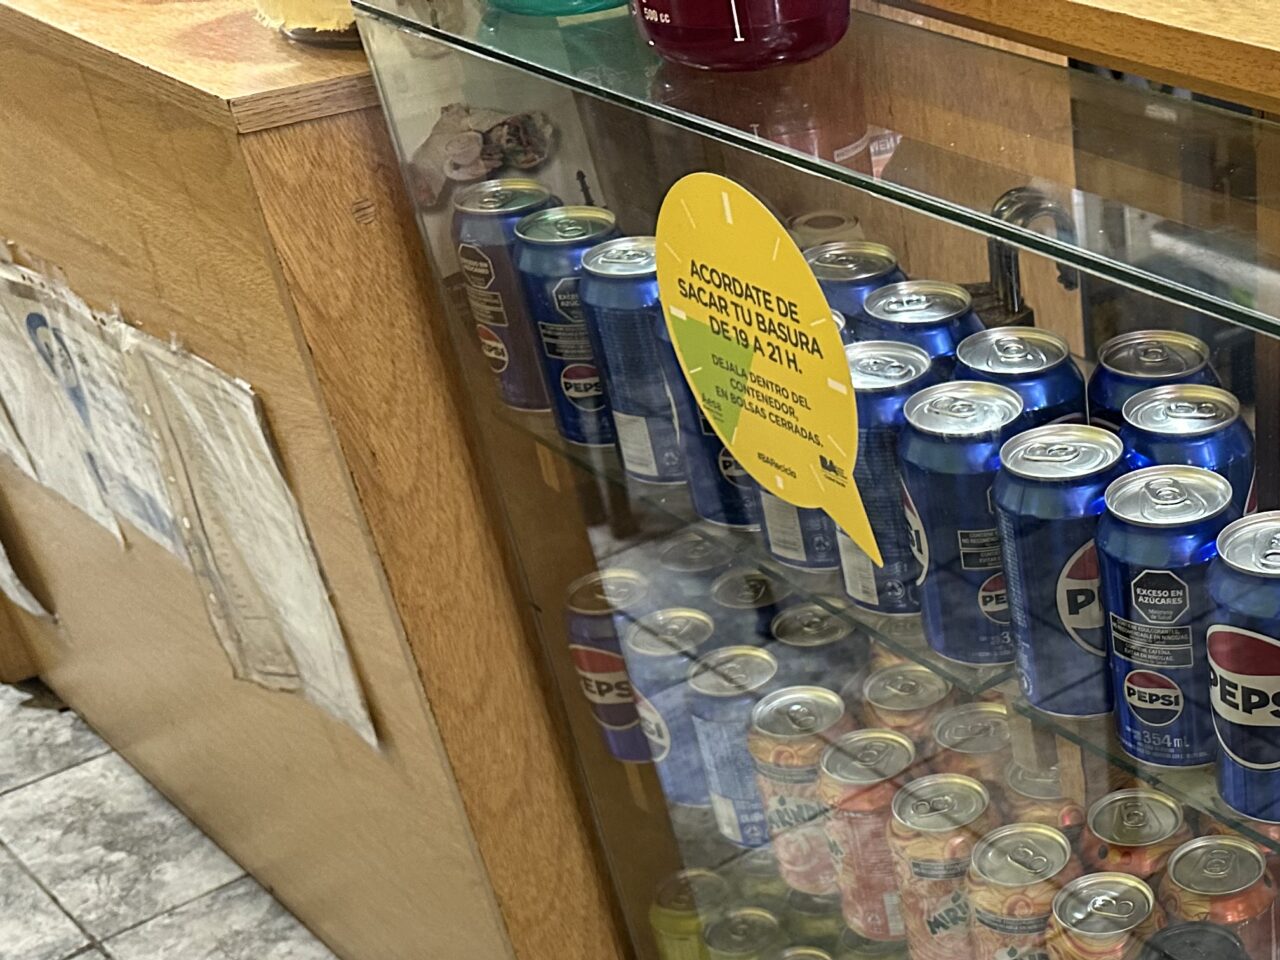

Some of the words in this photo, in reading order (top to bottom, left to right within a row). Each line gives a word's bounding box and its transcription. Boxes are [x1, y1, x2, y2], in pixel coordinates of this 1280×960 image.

[678, 277, 730, 317] SACAR
[730, 302, 753, 326] TU
[755, 312, 824, 360] BASURA
[690, 259, 774, 312] ACORDATE
[776, 296, 800, 324] DE
[709, 315, 732, 341] DE
[733, 326, 750, 349] 19
[753, 336, 766, 357] A
[766, 342, 784, 365] 21
[785, 350, 803, 374] H.
[712, 354, 748, 380] DEJALA
[750, 372, 790, 400] DENTRO
[791, 390, 812, 410] DEL
[730, 378, 800, 422] CONTENEDOR,
[716, 386, 729, 401] EN
[730, 392, 767, 420] BOLSAS
[768, 412, 824, 448] CERRADAS.
[1136, 588, 1169, 597] EXCESO
[1126, 686, 1180, 707] PEPSI
